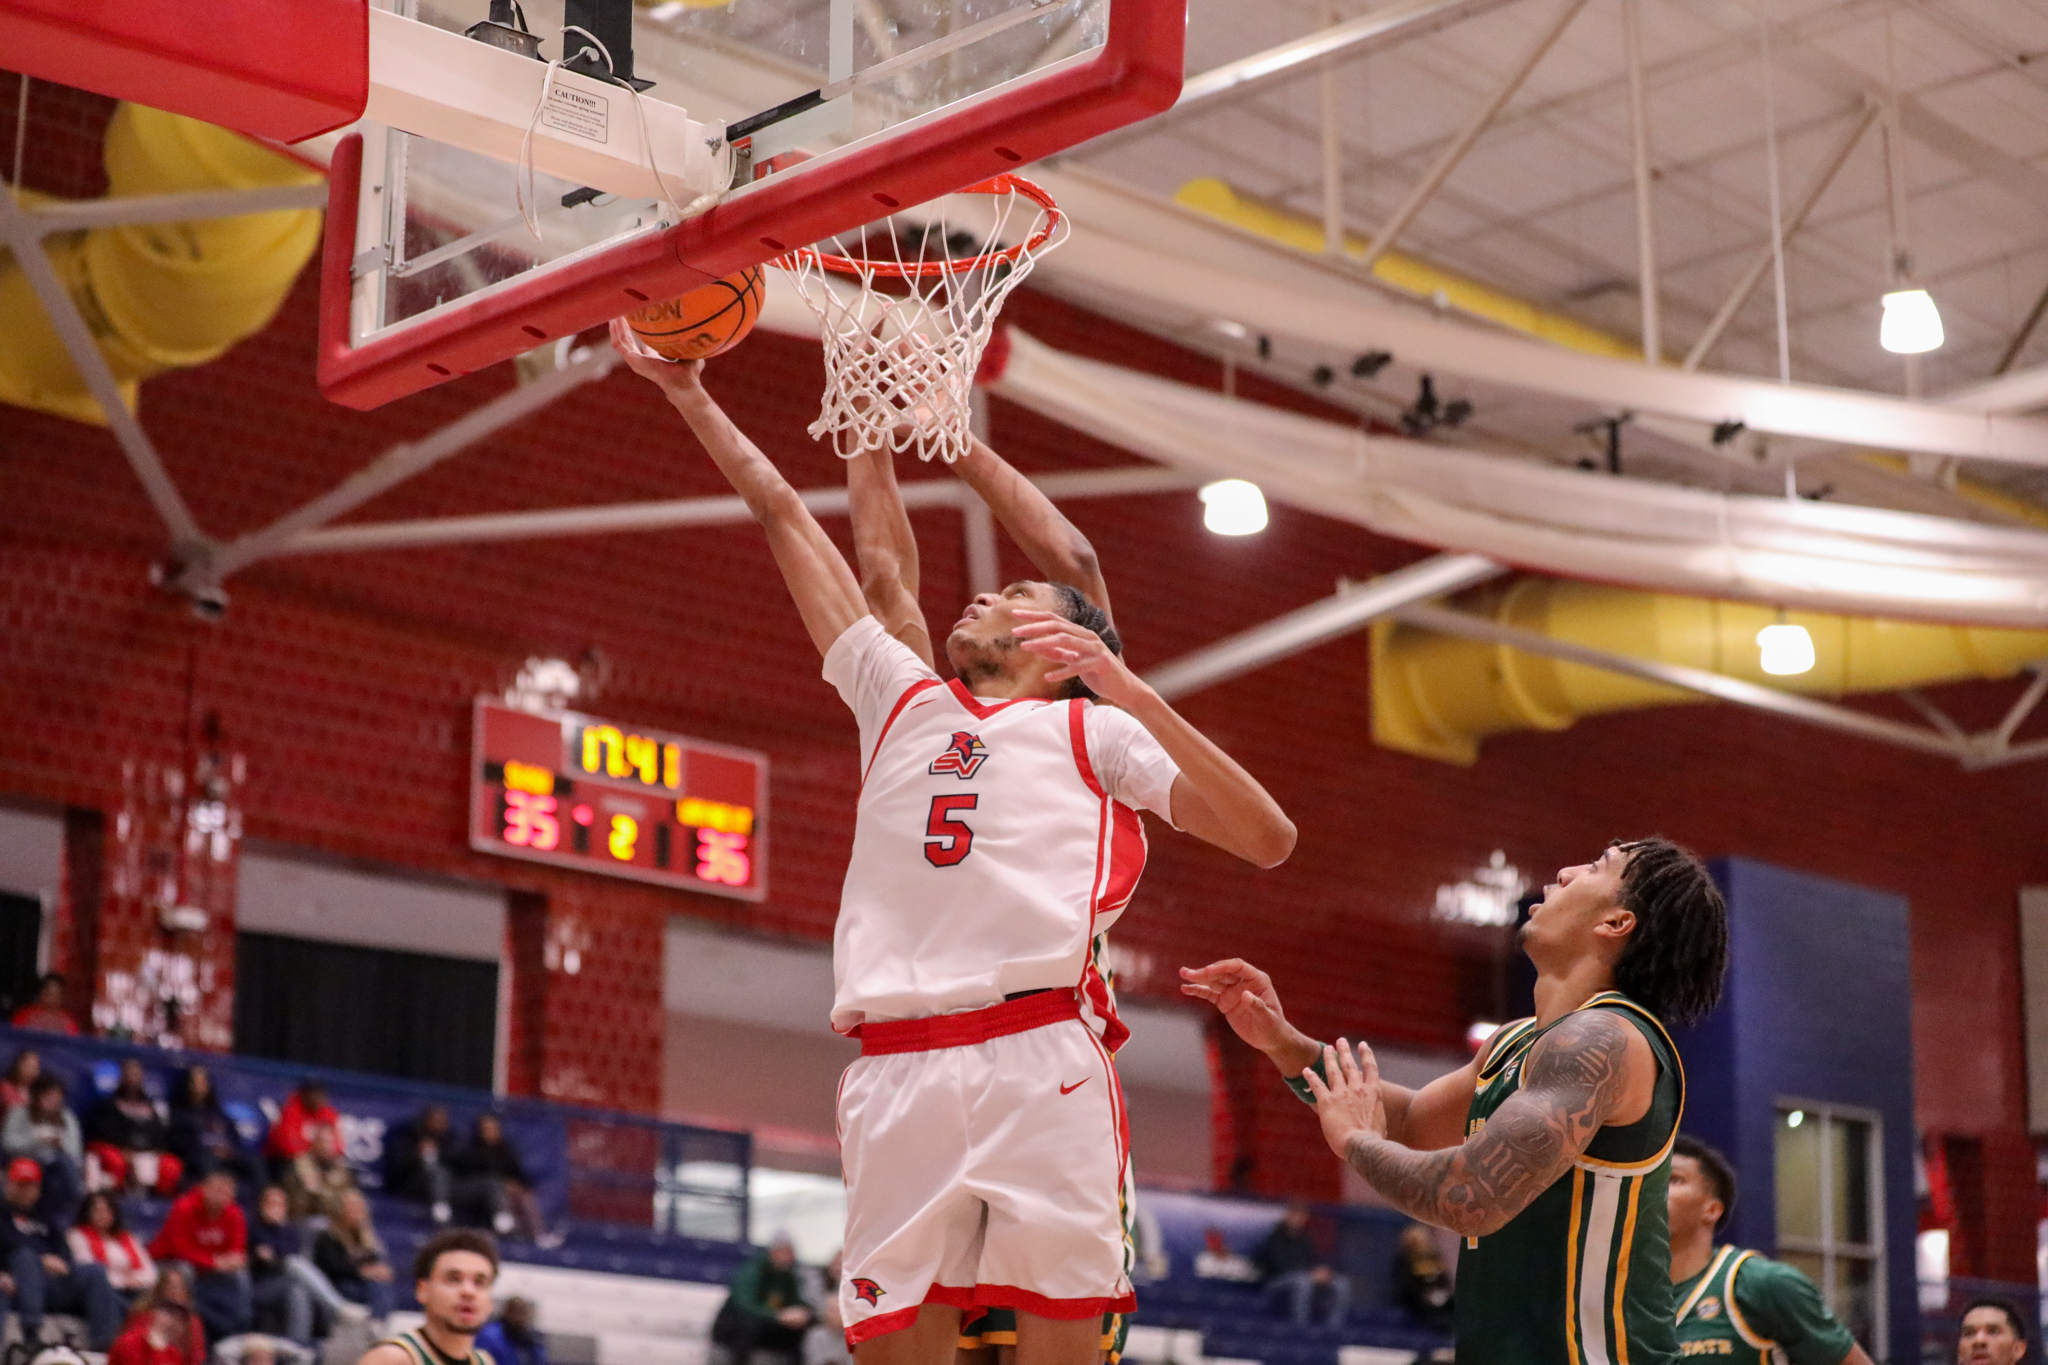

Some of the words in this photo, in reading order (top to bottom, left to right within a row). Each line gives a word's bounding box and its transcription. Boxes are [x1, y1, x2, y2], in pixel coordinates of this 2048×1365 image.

[555, 89, 596, 107] CAUTION!!!
[928, 751, 989, 780] SV
[504, 789, 559, 850] 35
[608, 814, 638, 861] 2
[924, 793, 978, 868] 5
[1679, 1338, 1734, 1357] TATE
